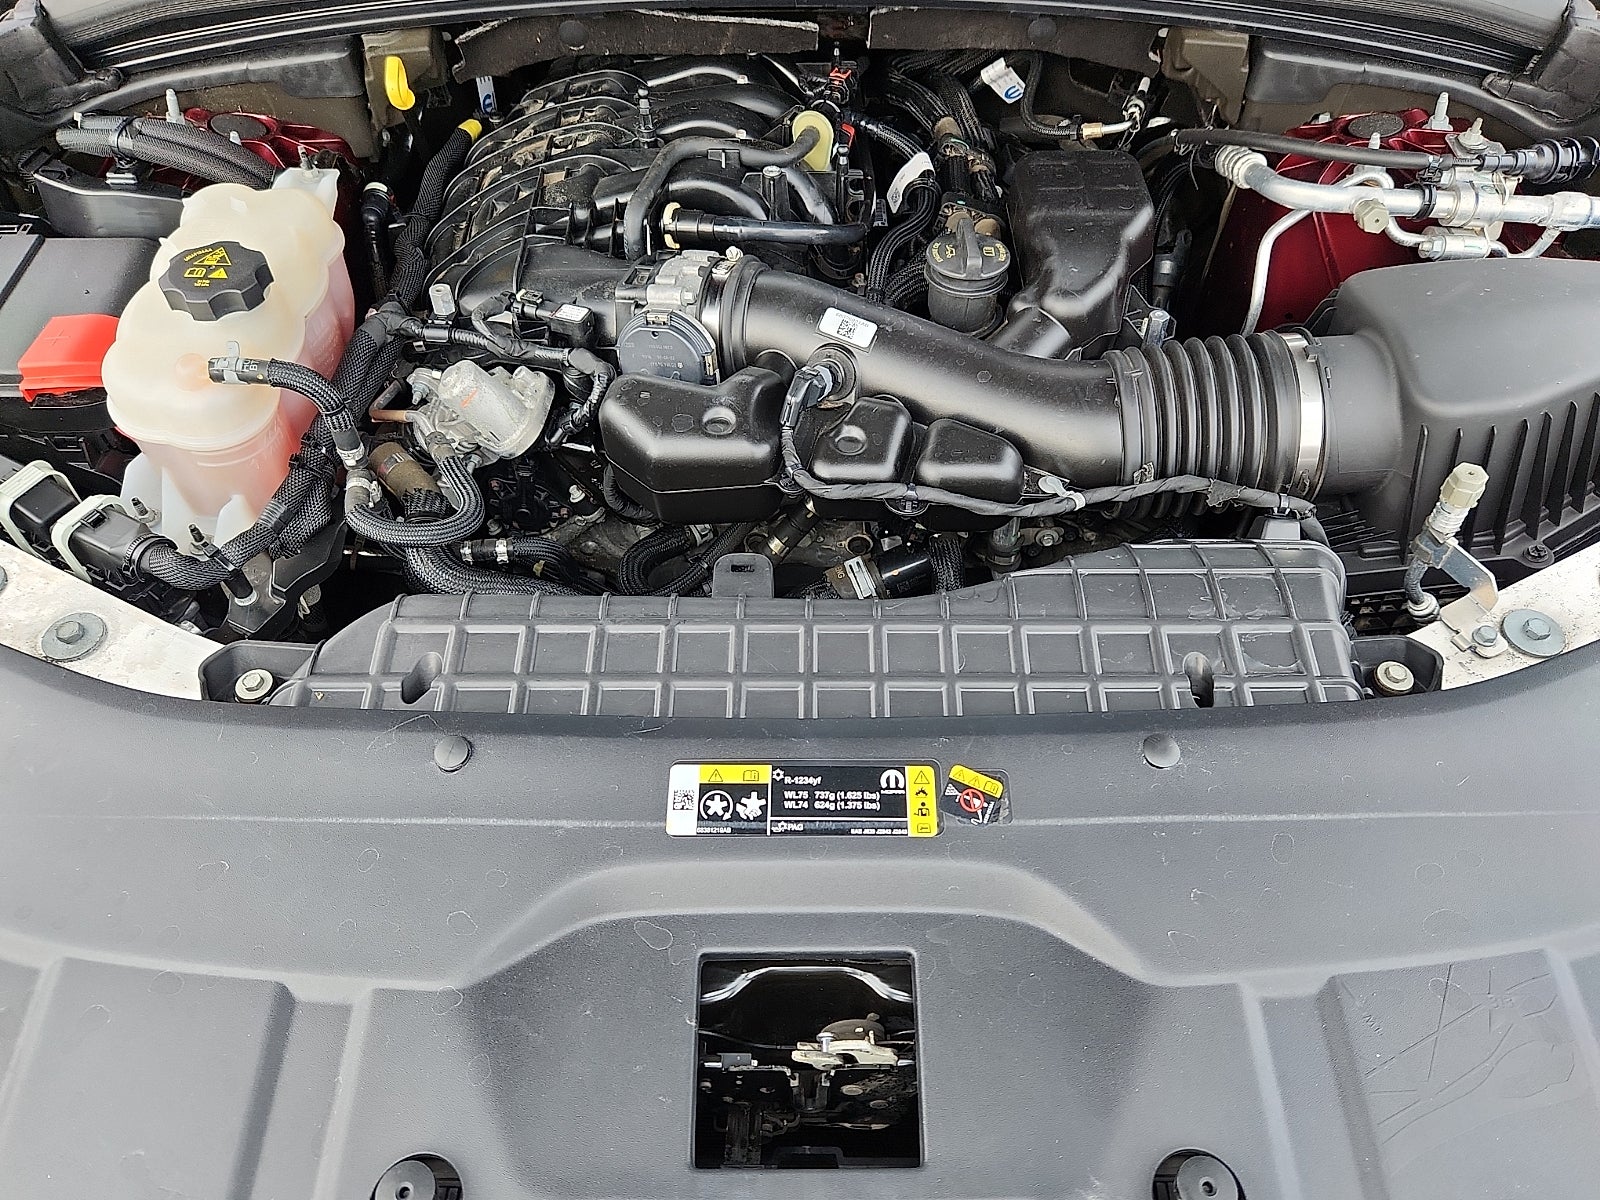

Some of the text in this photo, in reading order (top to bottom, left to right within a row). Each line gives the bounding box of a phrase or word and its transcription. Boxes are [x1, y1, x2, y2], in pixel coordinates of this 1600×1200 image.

[784, 776, 822, 787] R-1234yf
[784, 791, 880, 801] WL75 737g (1.625 lbs)
[784, 801, 880, 811] WL74 624g (1.375 lbs)
